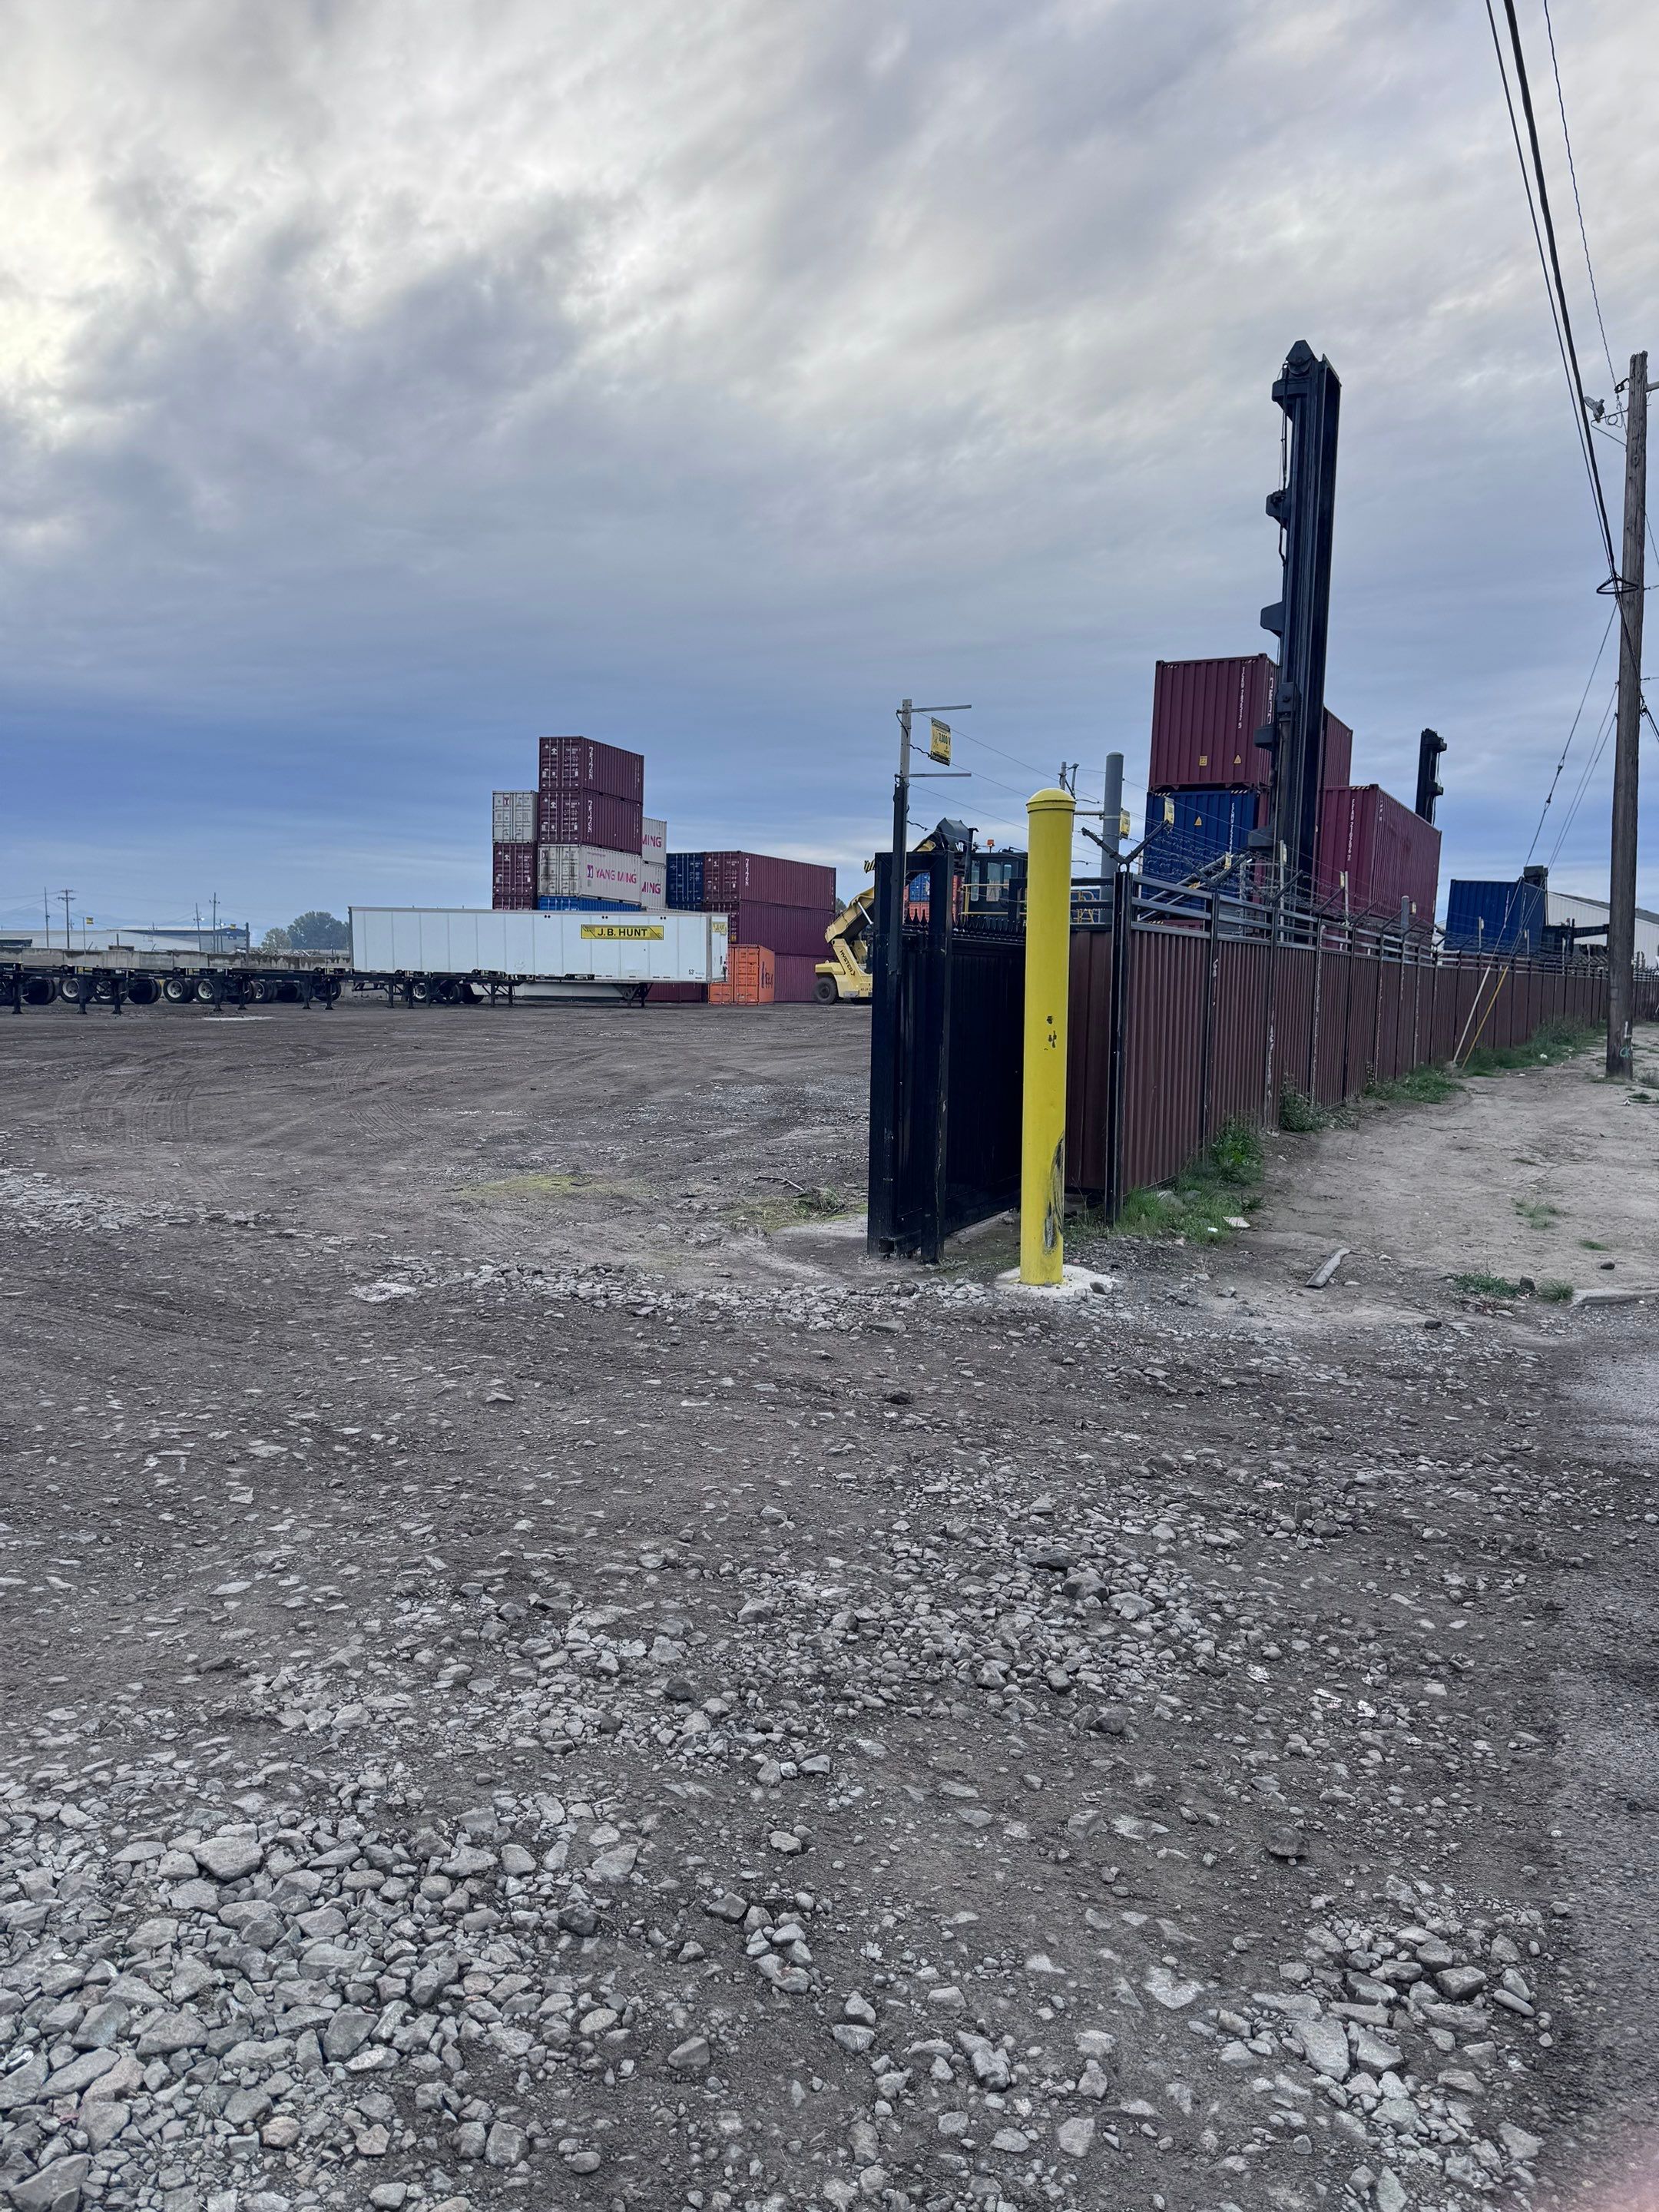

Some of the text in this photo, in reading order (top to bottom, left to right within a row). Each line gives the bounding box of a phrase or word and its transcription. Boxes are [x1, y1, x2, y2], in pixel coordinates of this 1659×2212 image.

[596, 867, 637, 884] YANG MING
[598, 928, 647, 937] J.B. HUNT
[839, 949, 853, 972] HYSTER
